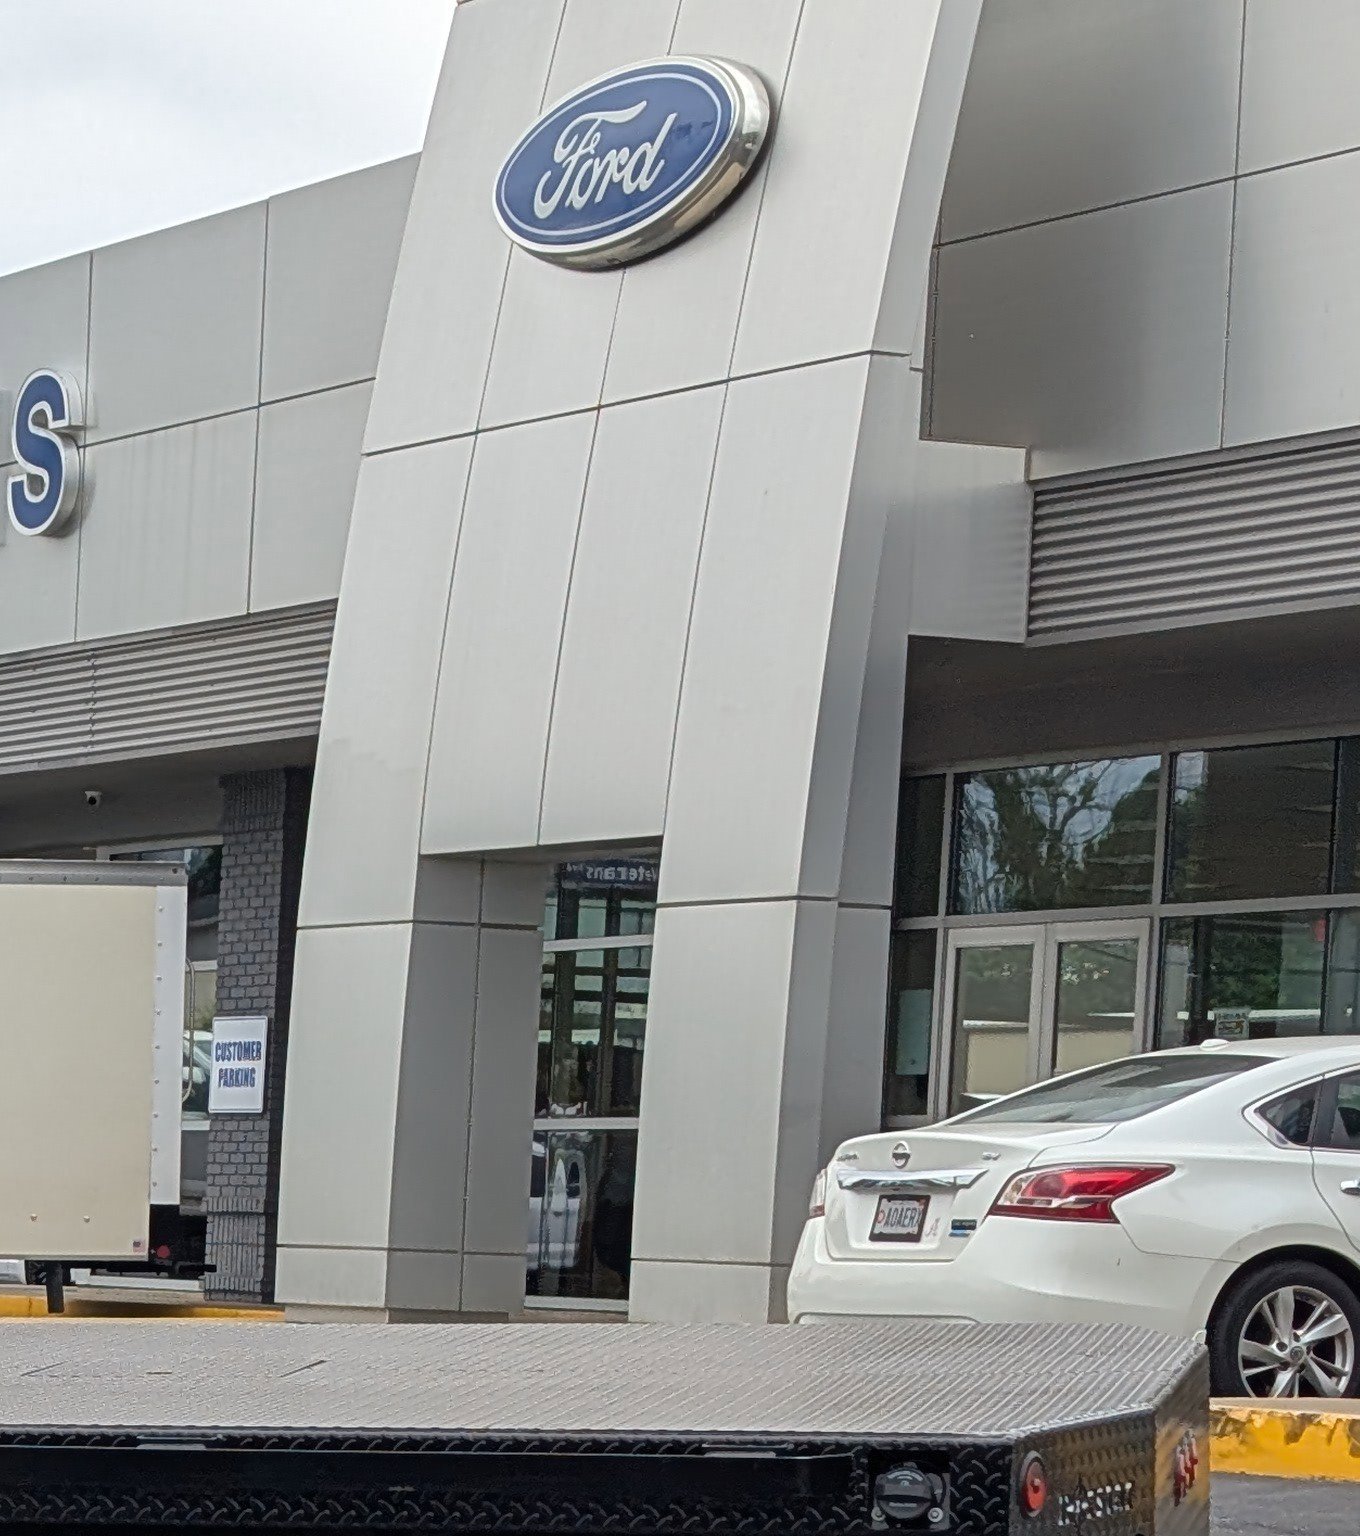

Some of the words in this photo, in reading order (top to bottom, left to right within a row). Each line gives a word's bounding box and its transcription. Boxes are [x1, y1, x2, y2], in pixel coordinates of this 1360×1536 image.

[534, 100, 678, 219] Ford
[215, 1040, 262, 1062] CUSTOMER
[218, 1067, 256, 1088] PARKING
